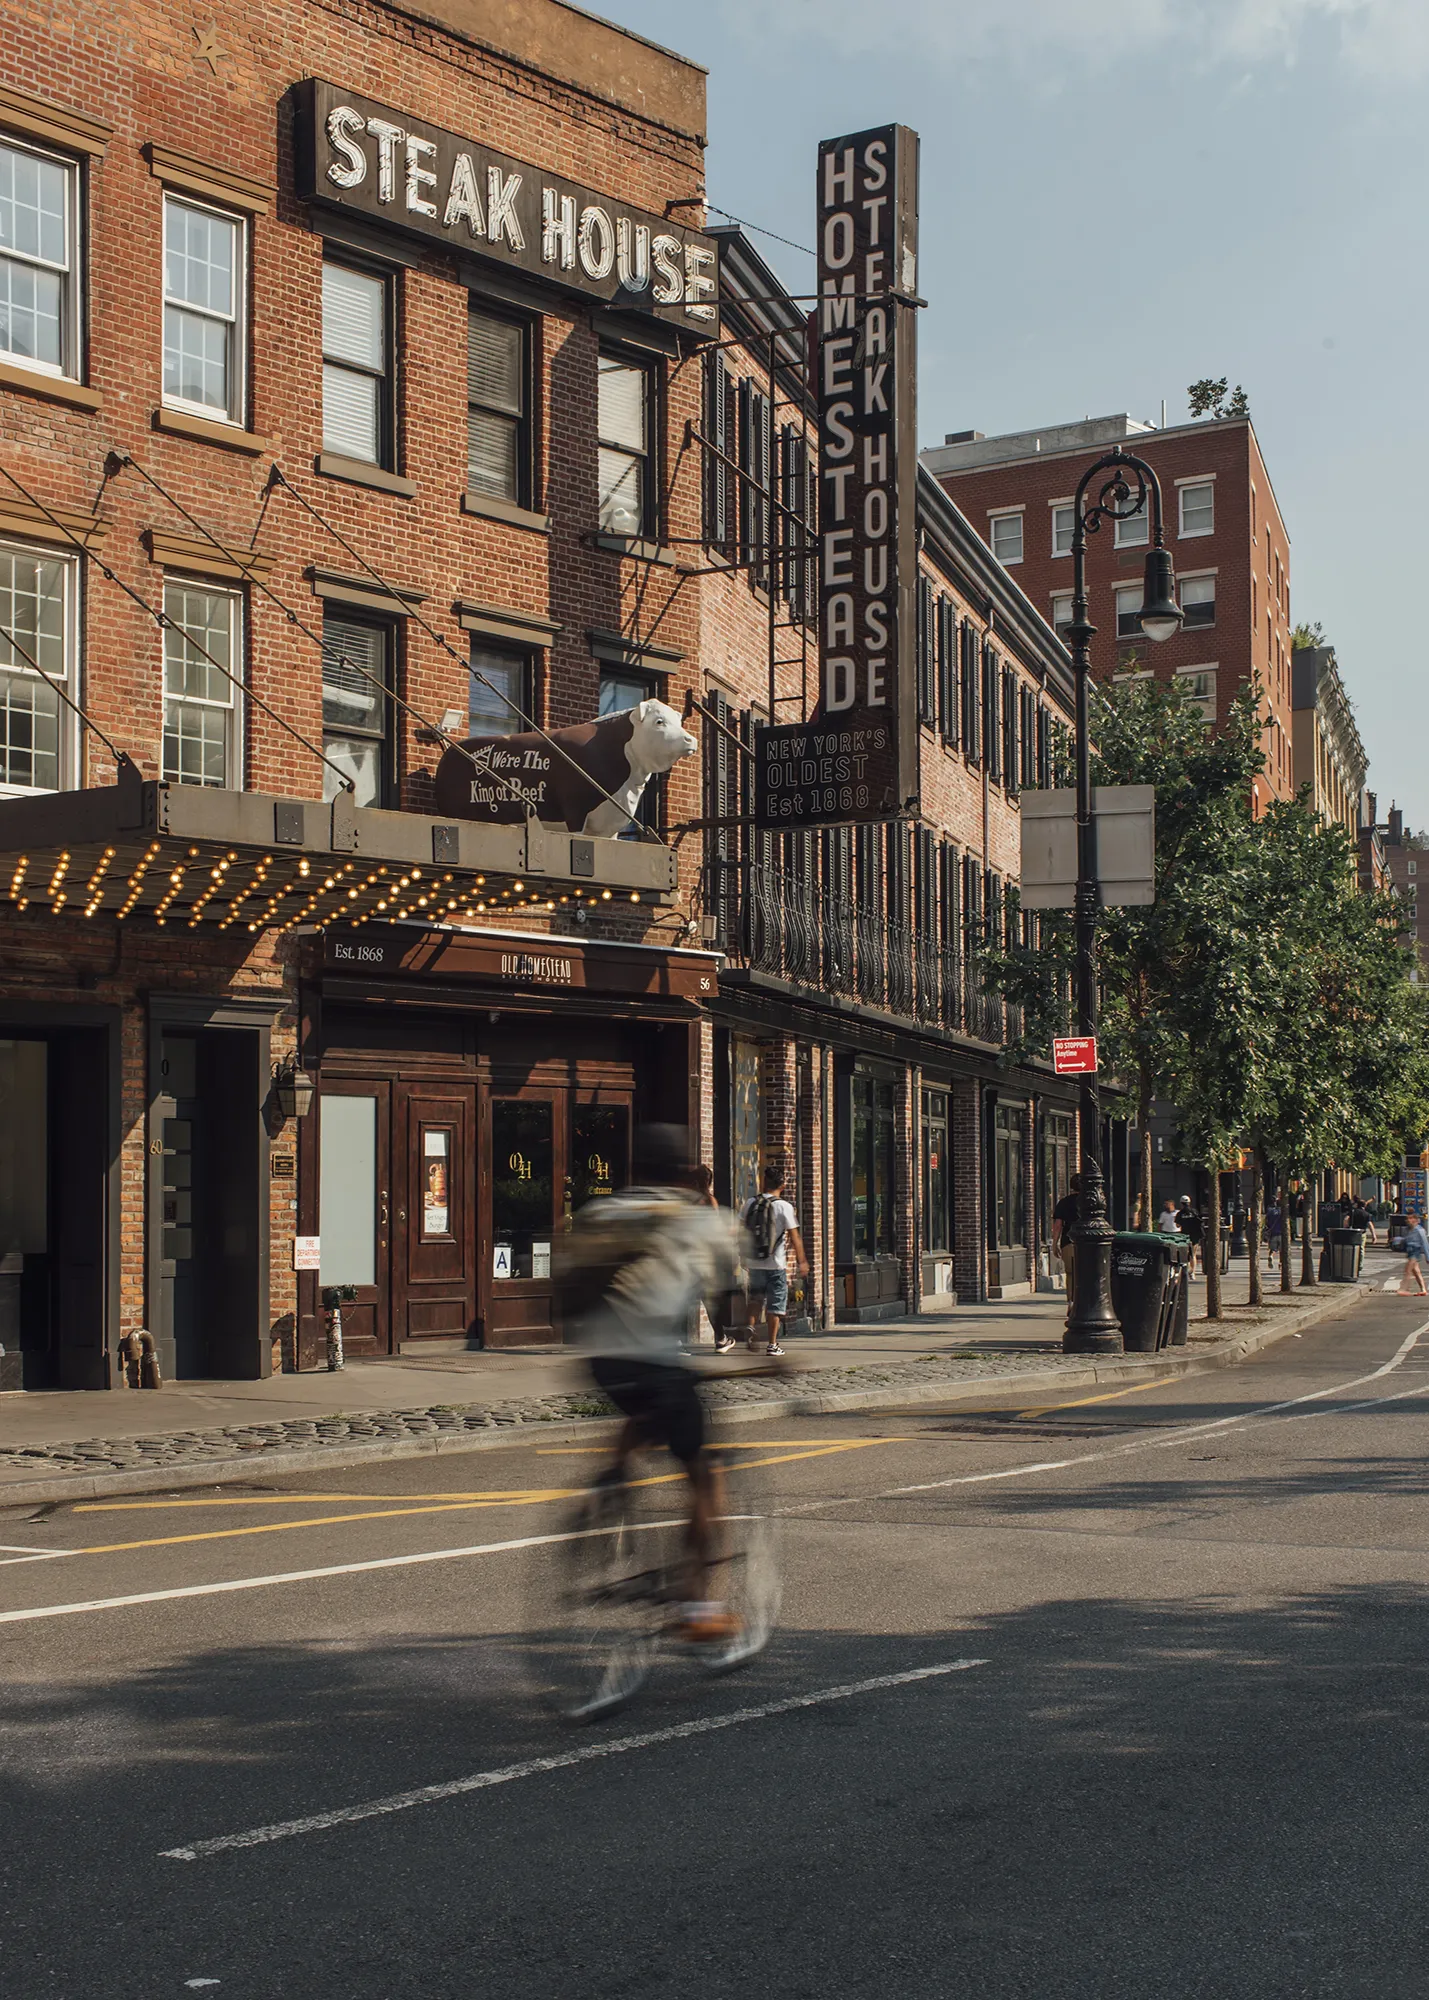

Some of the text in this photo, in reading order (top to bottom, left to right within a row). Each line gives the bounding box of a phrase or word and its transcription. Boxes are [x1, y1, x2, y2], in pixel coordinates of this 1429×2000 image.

[324, 105, 717, 322] STEAK HOUSE
[822, 147, 856, 713] HOMESTEAD
[862, 140, 888, 708] STEAK HOUSE
[766, 728, 886, 761] NEW YORK'S
[491, 750, 551, 771] We're The
[766, 753, 869, 789] OLDEST
[470, 779, 499, 813] King
[509, 777, 547, 802] Beef
[766, 784, 870, 817] Est 1868
[334, 943, 384, 962] Est. 1868
[501, 954, 571, 978] OLD HOMESTEAD
[537, 976, 571, 984] HOUSE
[700, 977, 710, 991] 56
[1057, 1050, 1078, 1059] Anytime
[1064, 1041, 1089, 1049] STOPPING
[150, 1138, 163, 1155] 60
[306, 1240, 315, 1248] FIRE
[496, 1251, 508, 1270] A
